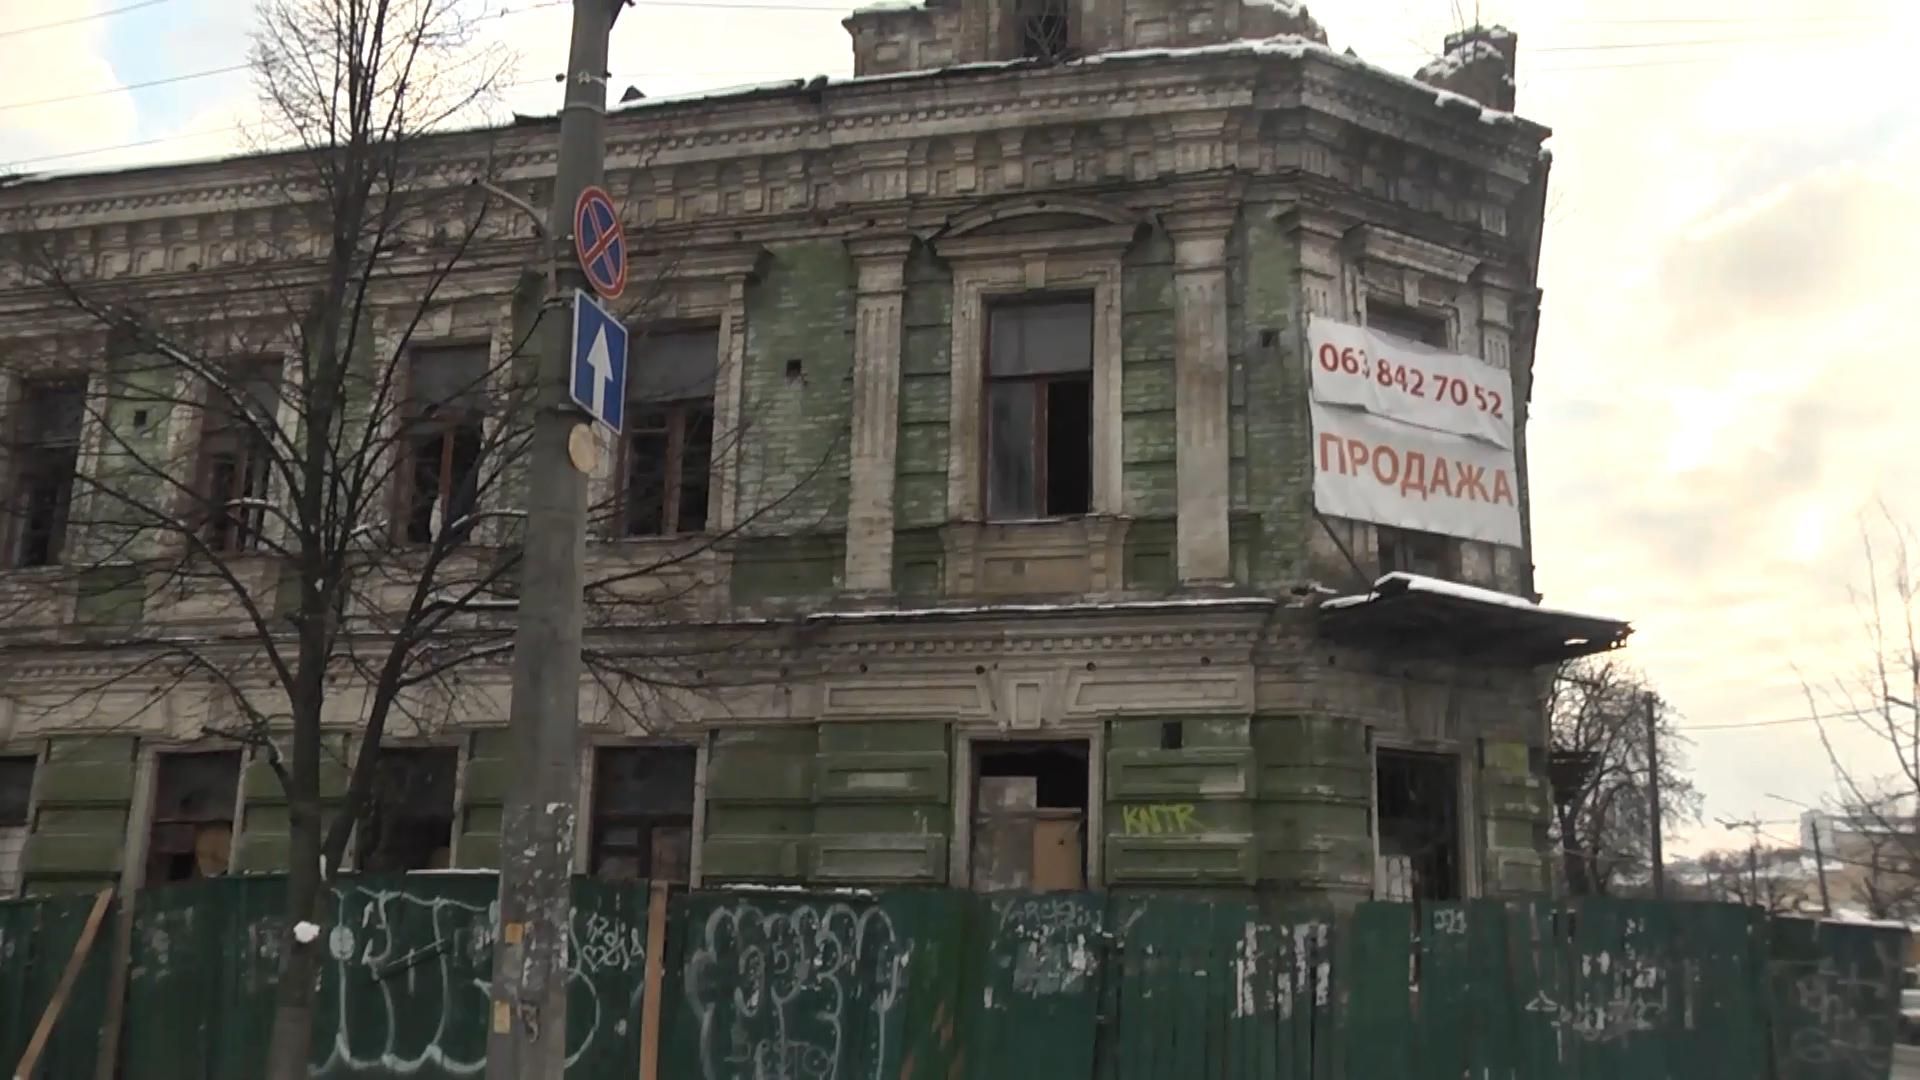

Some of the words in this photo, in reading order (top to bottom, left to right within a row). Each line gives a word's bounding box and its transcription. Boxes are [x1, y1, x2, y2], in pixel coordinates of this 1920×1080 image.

[1377, 358, 1425, 398] 842
[1433, 374, 1468, 406] 70
[1474, 384, 1503, 419] 52
[1319, 432, 1514, 507] ПРОДАЖА
